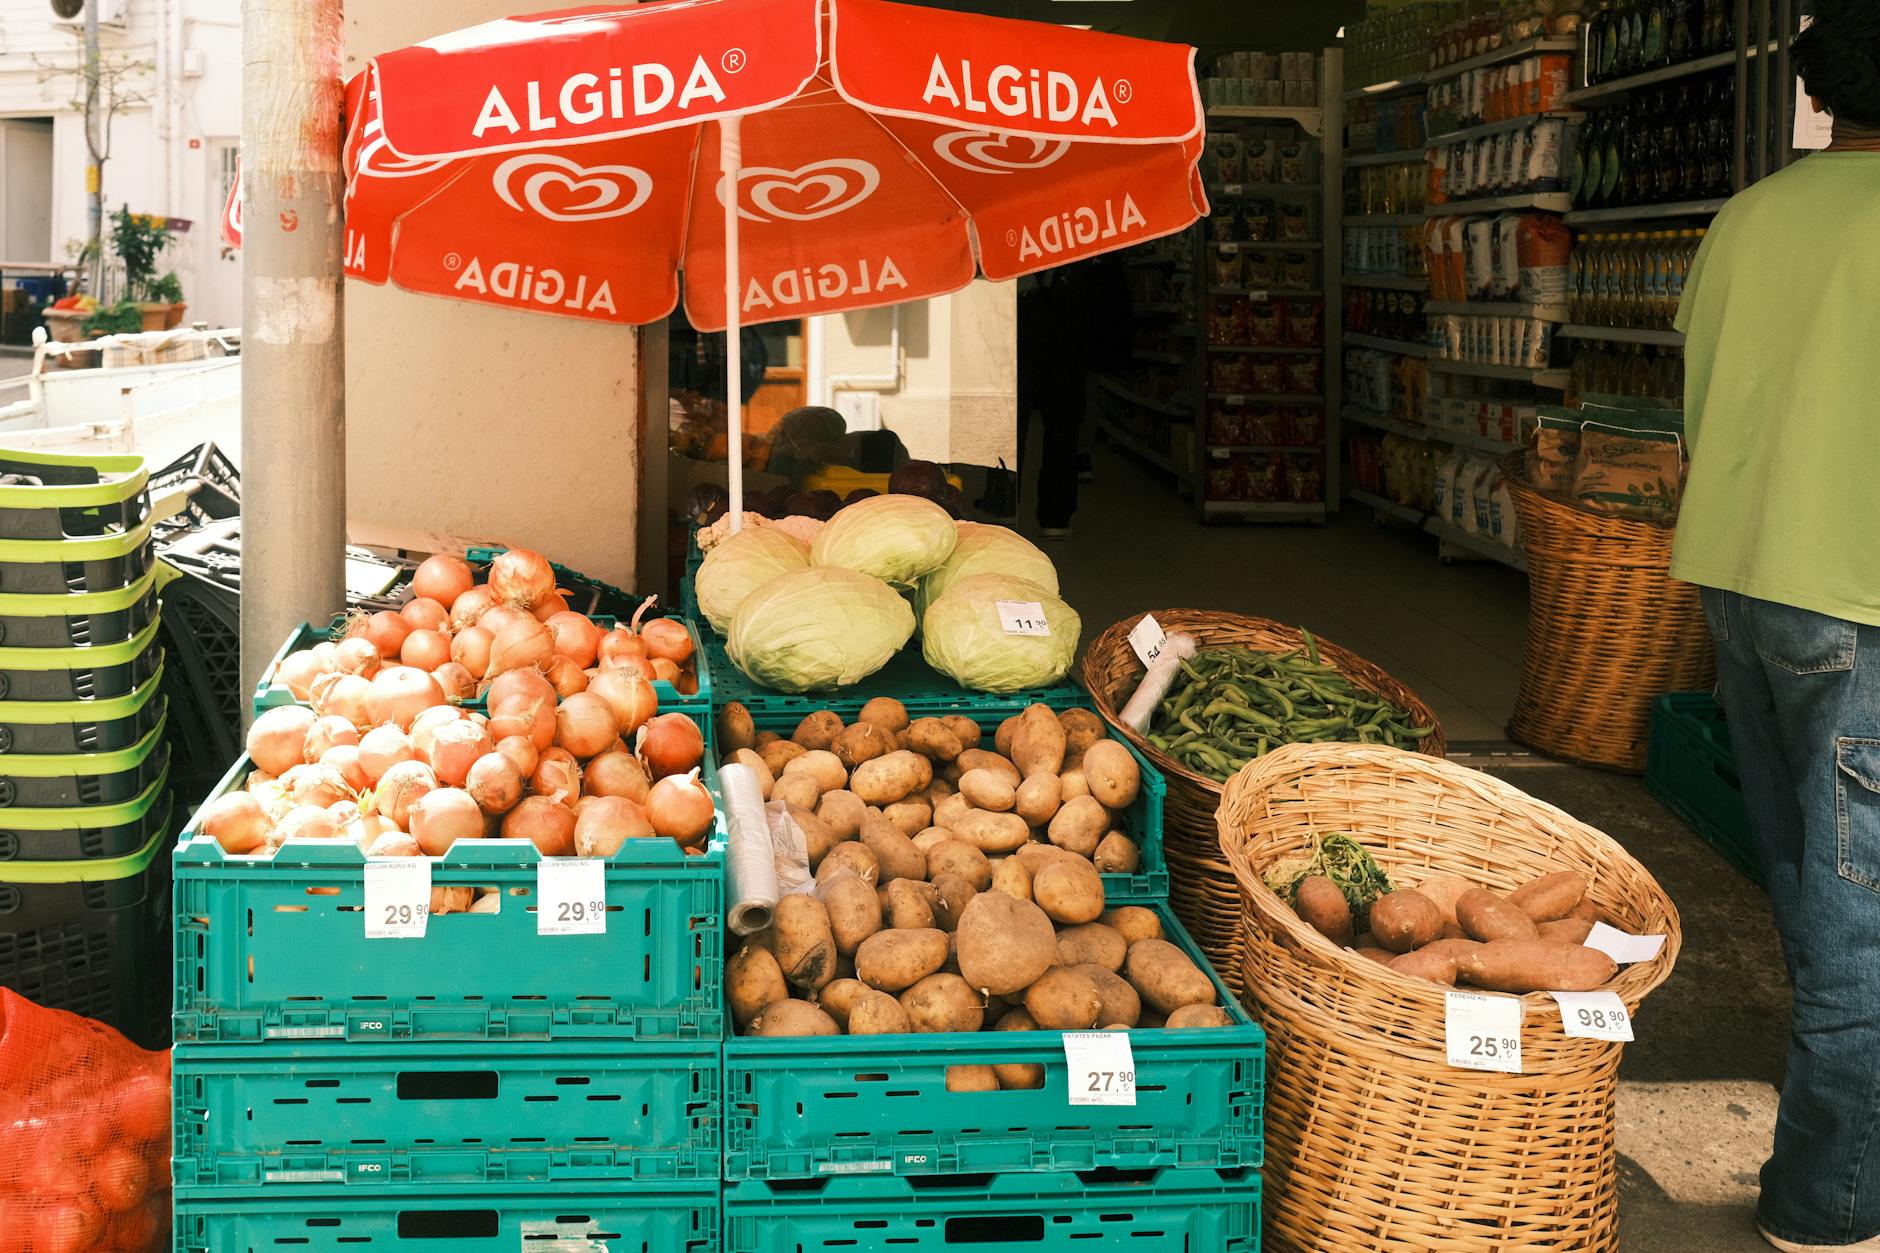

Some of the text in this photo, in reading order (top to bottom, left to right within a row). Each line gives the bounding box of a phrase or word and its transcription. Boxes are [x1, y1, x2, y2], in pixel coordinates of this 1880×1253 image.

[360, 1022, 382, 1030] IFCO
[905, 1155, 927, 1163] IFCO
[358, 1164, 381, 1172] IFCO
